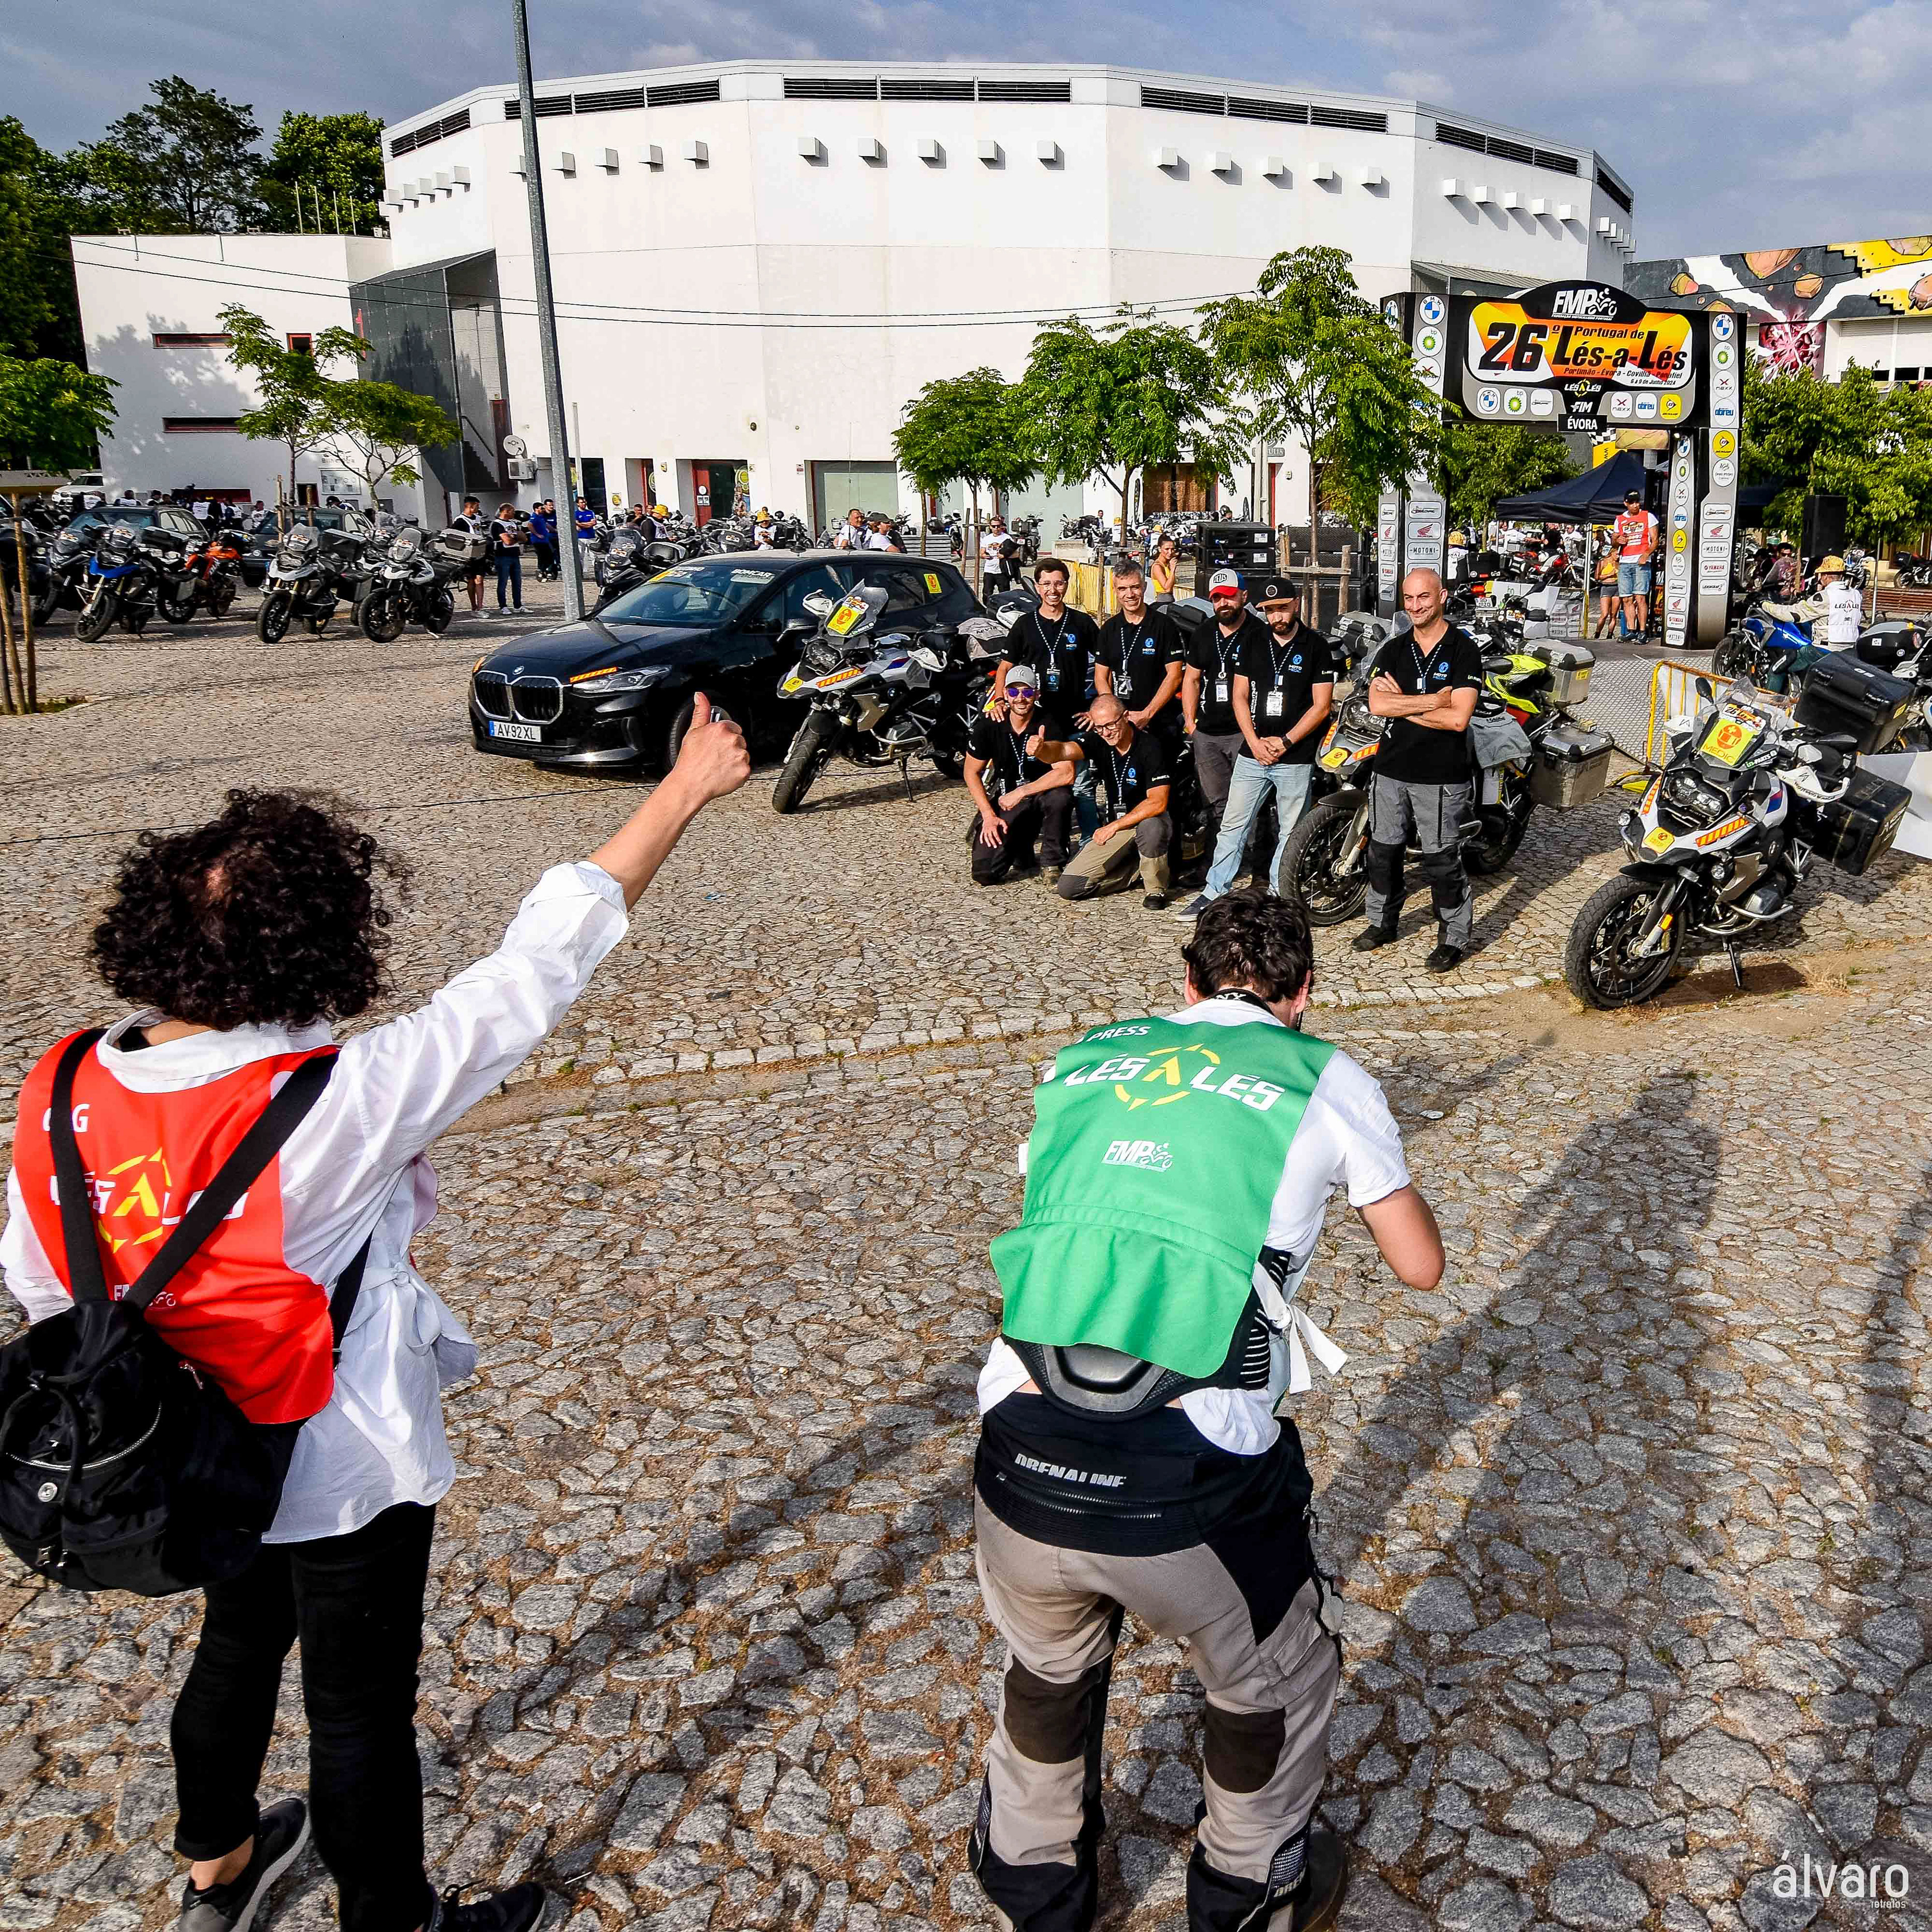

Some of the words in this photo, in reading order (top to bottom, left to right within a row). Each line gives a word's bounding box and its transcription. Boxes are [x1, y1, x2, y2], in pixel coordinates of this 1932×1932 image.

[1422, 297, 1442, 305] BMW
[1553, 289, 1597, 315] FMP
[1574, 326, 1628, 340] Portugal
[1630, 329, 1645, 340] de
[1552, 325, 1687, 370] Lés-a-Lés
[1564, 367, 1597, 375] Portimão
[1601, 368, 1622, 376] Évora
[1571, 401, 1593, 413] FIM
[1567, 416, 1598, 430] ÉVORA
[731, 569, 773, 578] BOMCAR
[1704, 744, 1735, 764] MEDIC
[1086, 1025, 1152, 1043] PRESS
